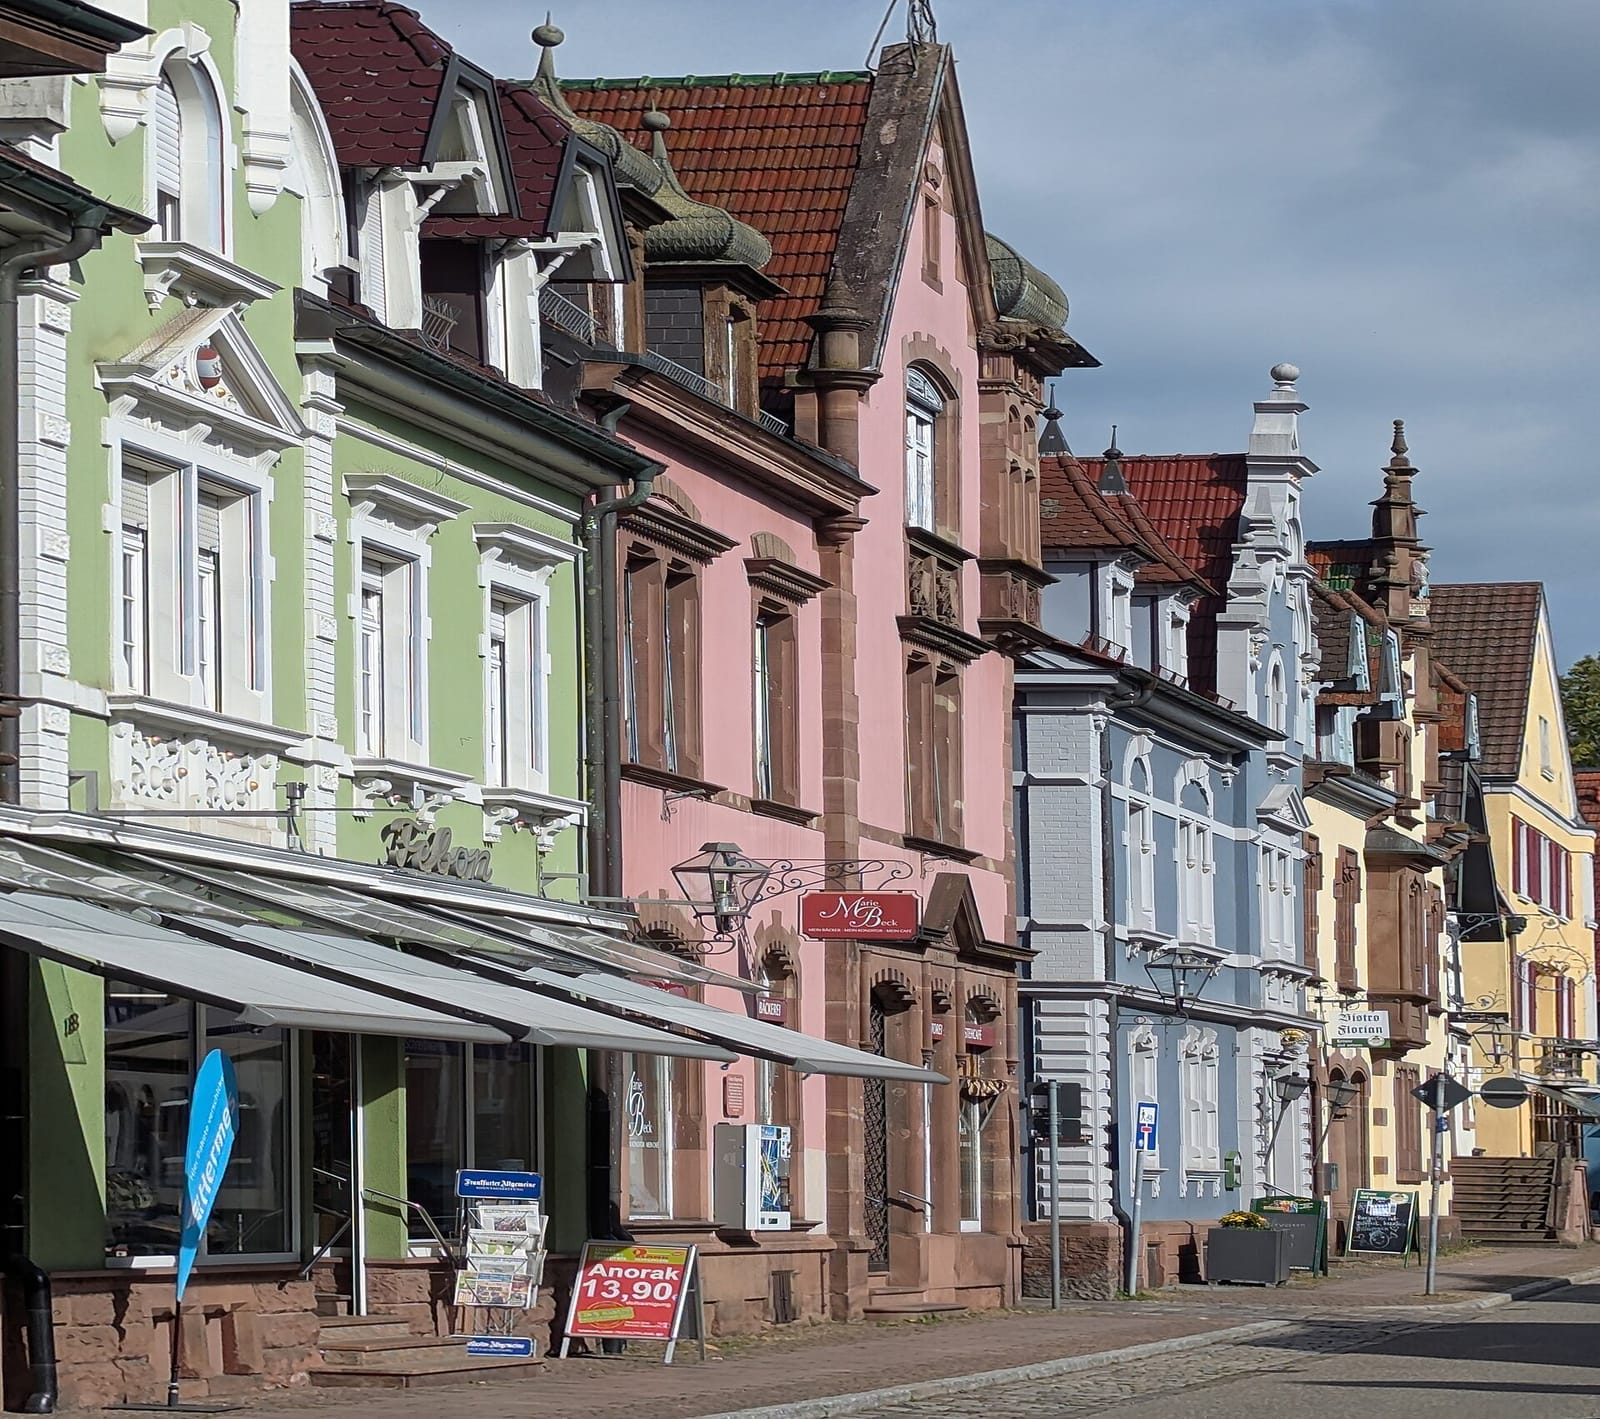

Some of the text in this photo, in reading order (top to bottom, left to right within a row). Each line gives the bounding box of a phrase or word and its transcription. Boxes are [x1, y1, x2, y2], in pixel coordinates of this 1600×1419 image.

[819, 896, 879, 918] Marie
[849, 906, 899, 928] Beck
[1338, 1013, 1380, 1022] Bistro
[1337, 1024, 1383, 1036] Florian
[464, 1178, 537, 1188] Frankfurter Allgemeine
[587, 1263, 680, 1280] Anorak
